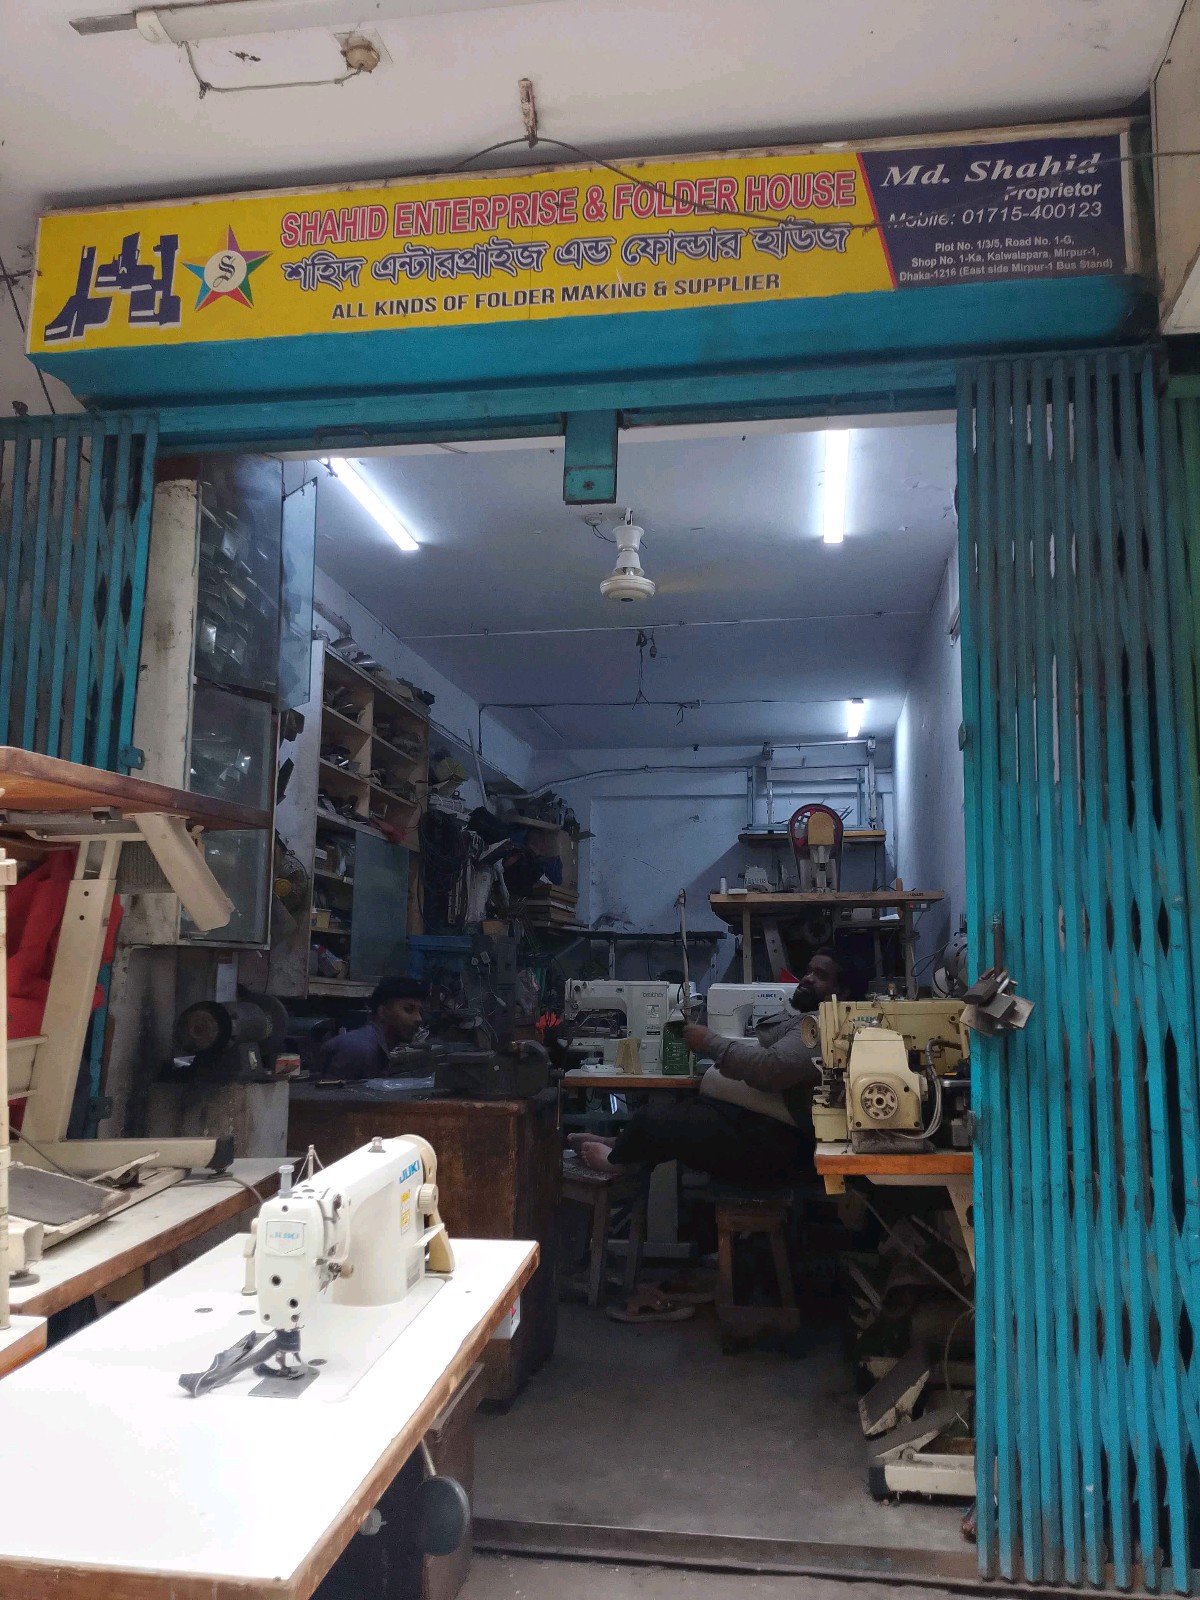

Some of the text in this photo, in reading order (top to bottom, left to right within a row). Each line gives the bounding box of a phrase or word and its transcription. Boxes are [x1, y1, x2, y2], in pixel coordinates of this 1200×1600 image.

[880, 152, 1101, 187] Md. Shahid
[1003, 182, 1102, 203] Proprietor
[281, 168, 857, 248] SHAHID ENTERPRISE & FOLDER HOUSE
[962, 201, 1102, 225] 01715-400123
[281, 216, 852, 291] শহিদ এন্টারপ্রাইজ এন্ড ফোল্ডার হাউজ
[935, 242, 955, 252] Plot
[957, 240, 973, 251] No.
[1005, 237, 1031, 248] Road
[1034, 236, 1051, 246] No.
[911, 257, 937, 269] Shop
[939, 255, 956, 266] No.
[959, 253, 985, 264] 1-Ka,
[1054, 246, 1100, 258] Mirpur-1,
[899, 258, 1114, 282] Dhaka-1216 (East side Mirpur-1 Bus Stand)
[332, 273, 780, 320] ALL KINDS OF FOLDER MAKING & SUPPLIER
[399, 1159, 420, 1184] JUKI
